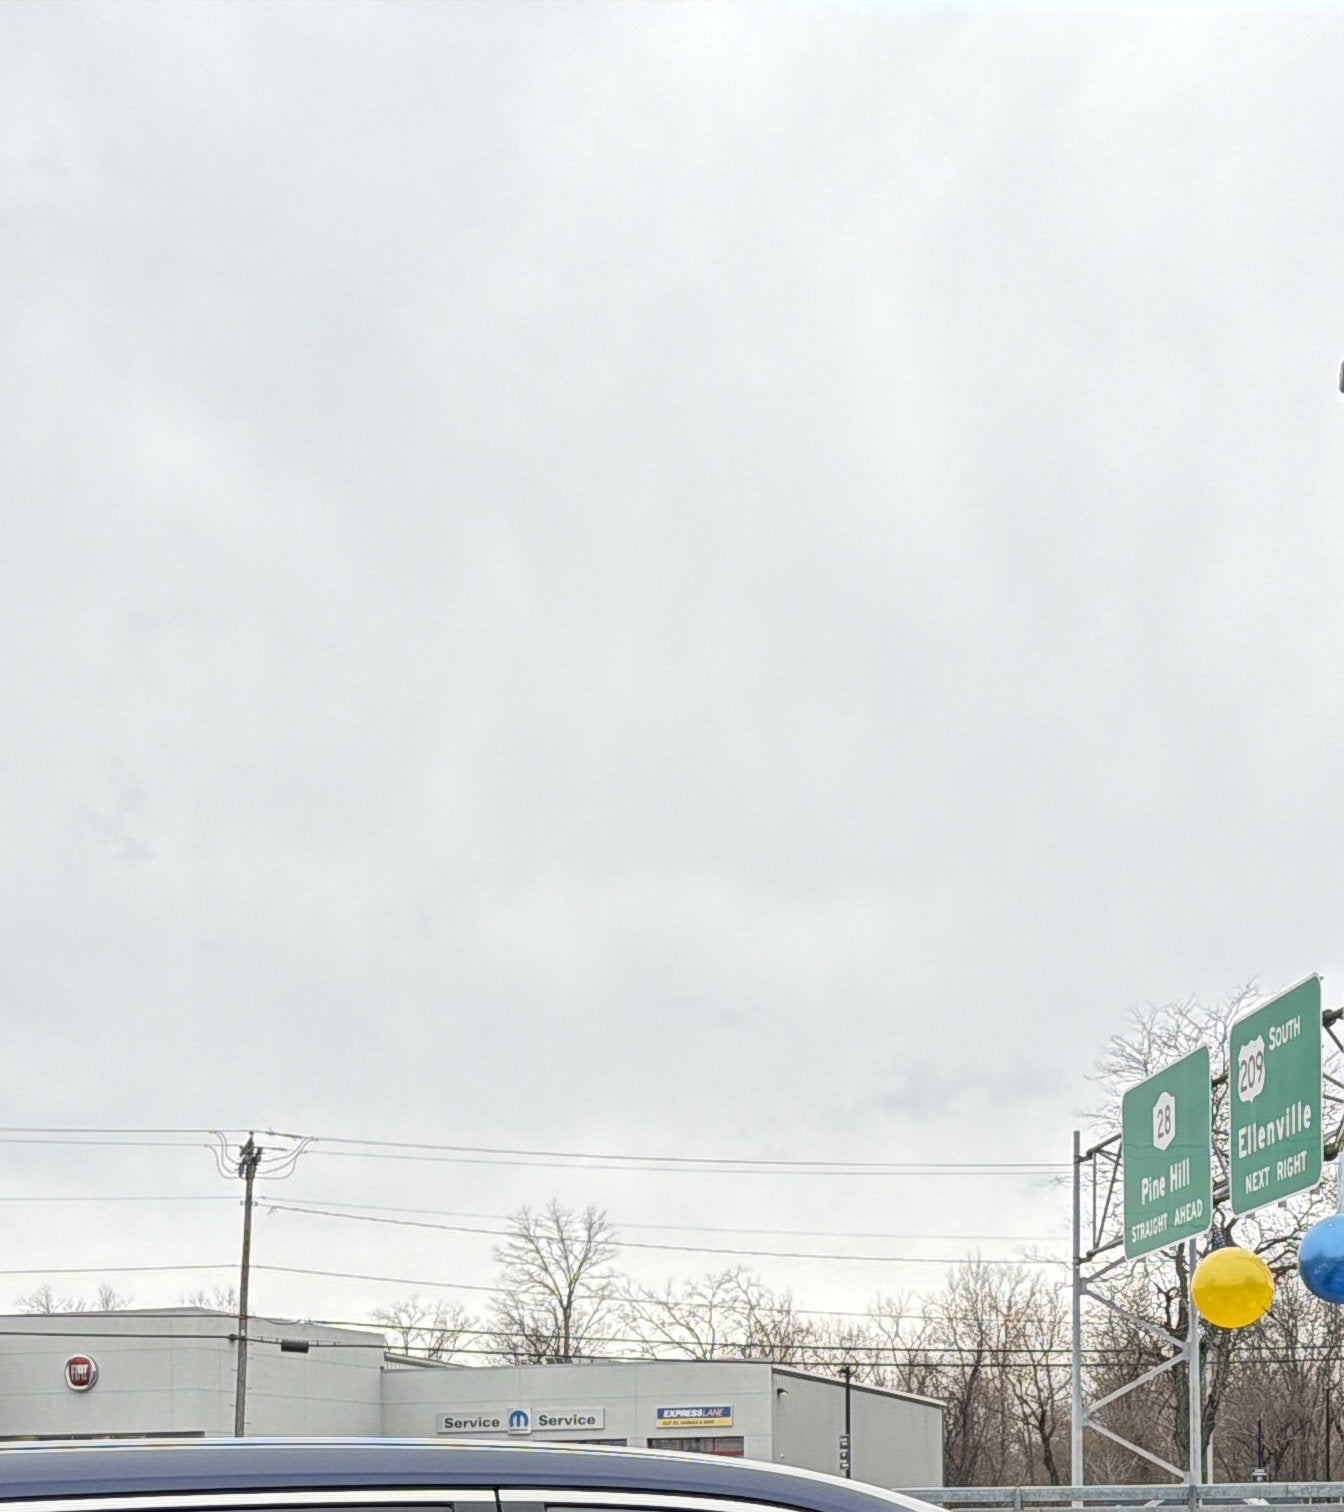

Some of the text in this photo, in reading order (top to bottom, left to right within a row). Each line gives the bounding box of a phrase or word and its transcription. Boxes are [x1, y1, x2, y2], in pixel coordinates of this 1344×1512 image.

[1268, 1015, 1301, 1051] SOUTH
[1240, 1050, 1264, 1093] 209
[1157, 1105, 1171, 1138] 28
[1238, 1100, 1312, 1159] Ellenville
[1141, 1157, 1190, 1205] Pine Hill
[1245, 1149, 1307, 1194] NEXT RIGHT
[1131, 1199, 1203, 1243] STRAIGHT AHEAD
[444, 1416, 500, 1429] Service
[539, 1413, 596, 1427] Service
